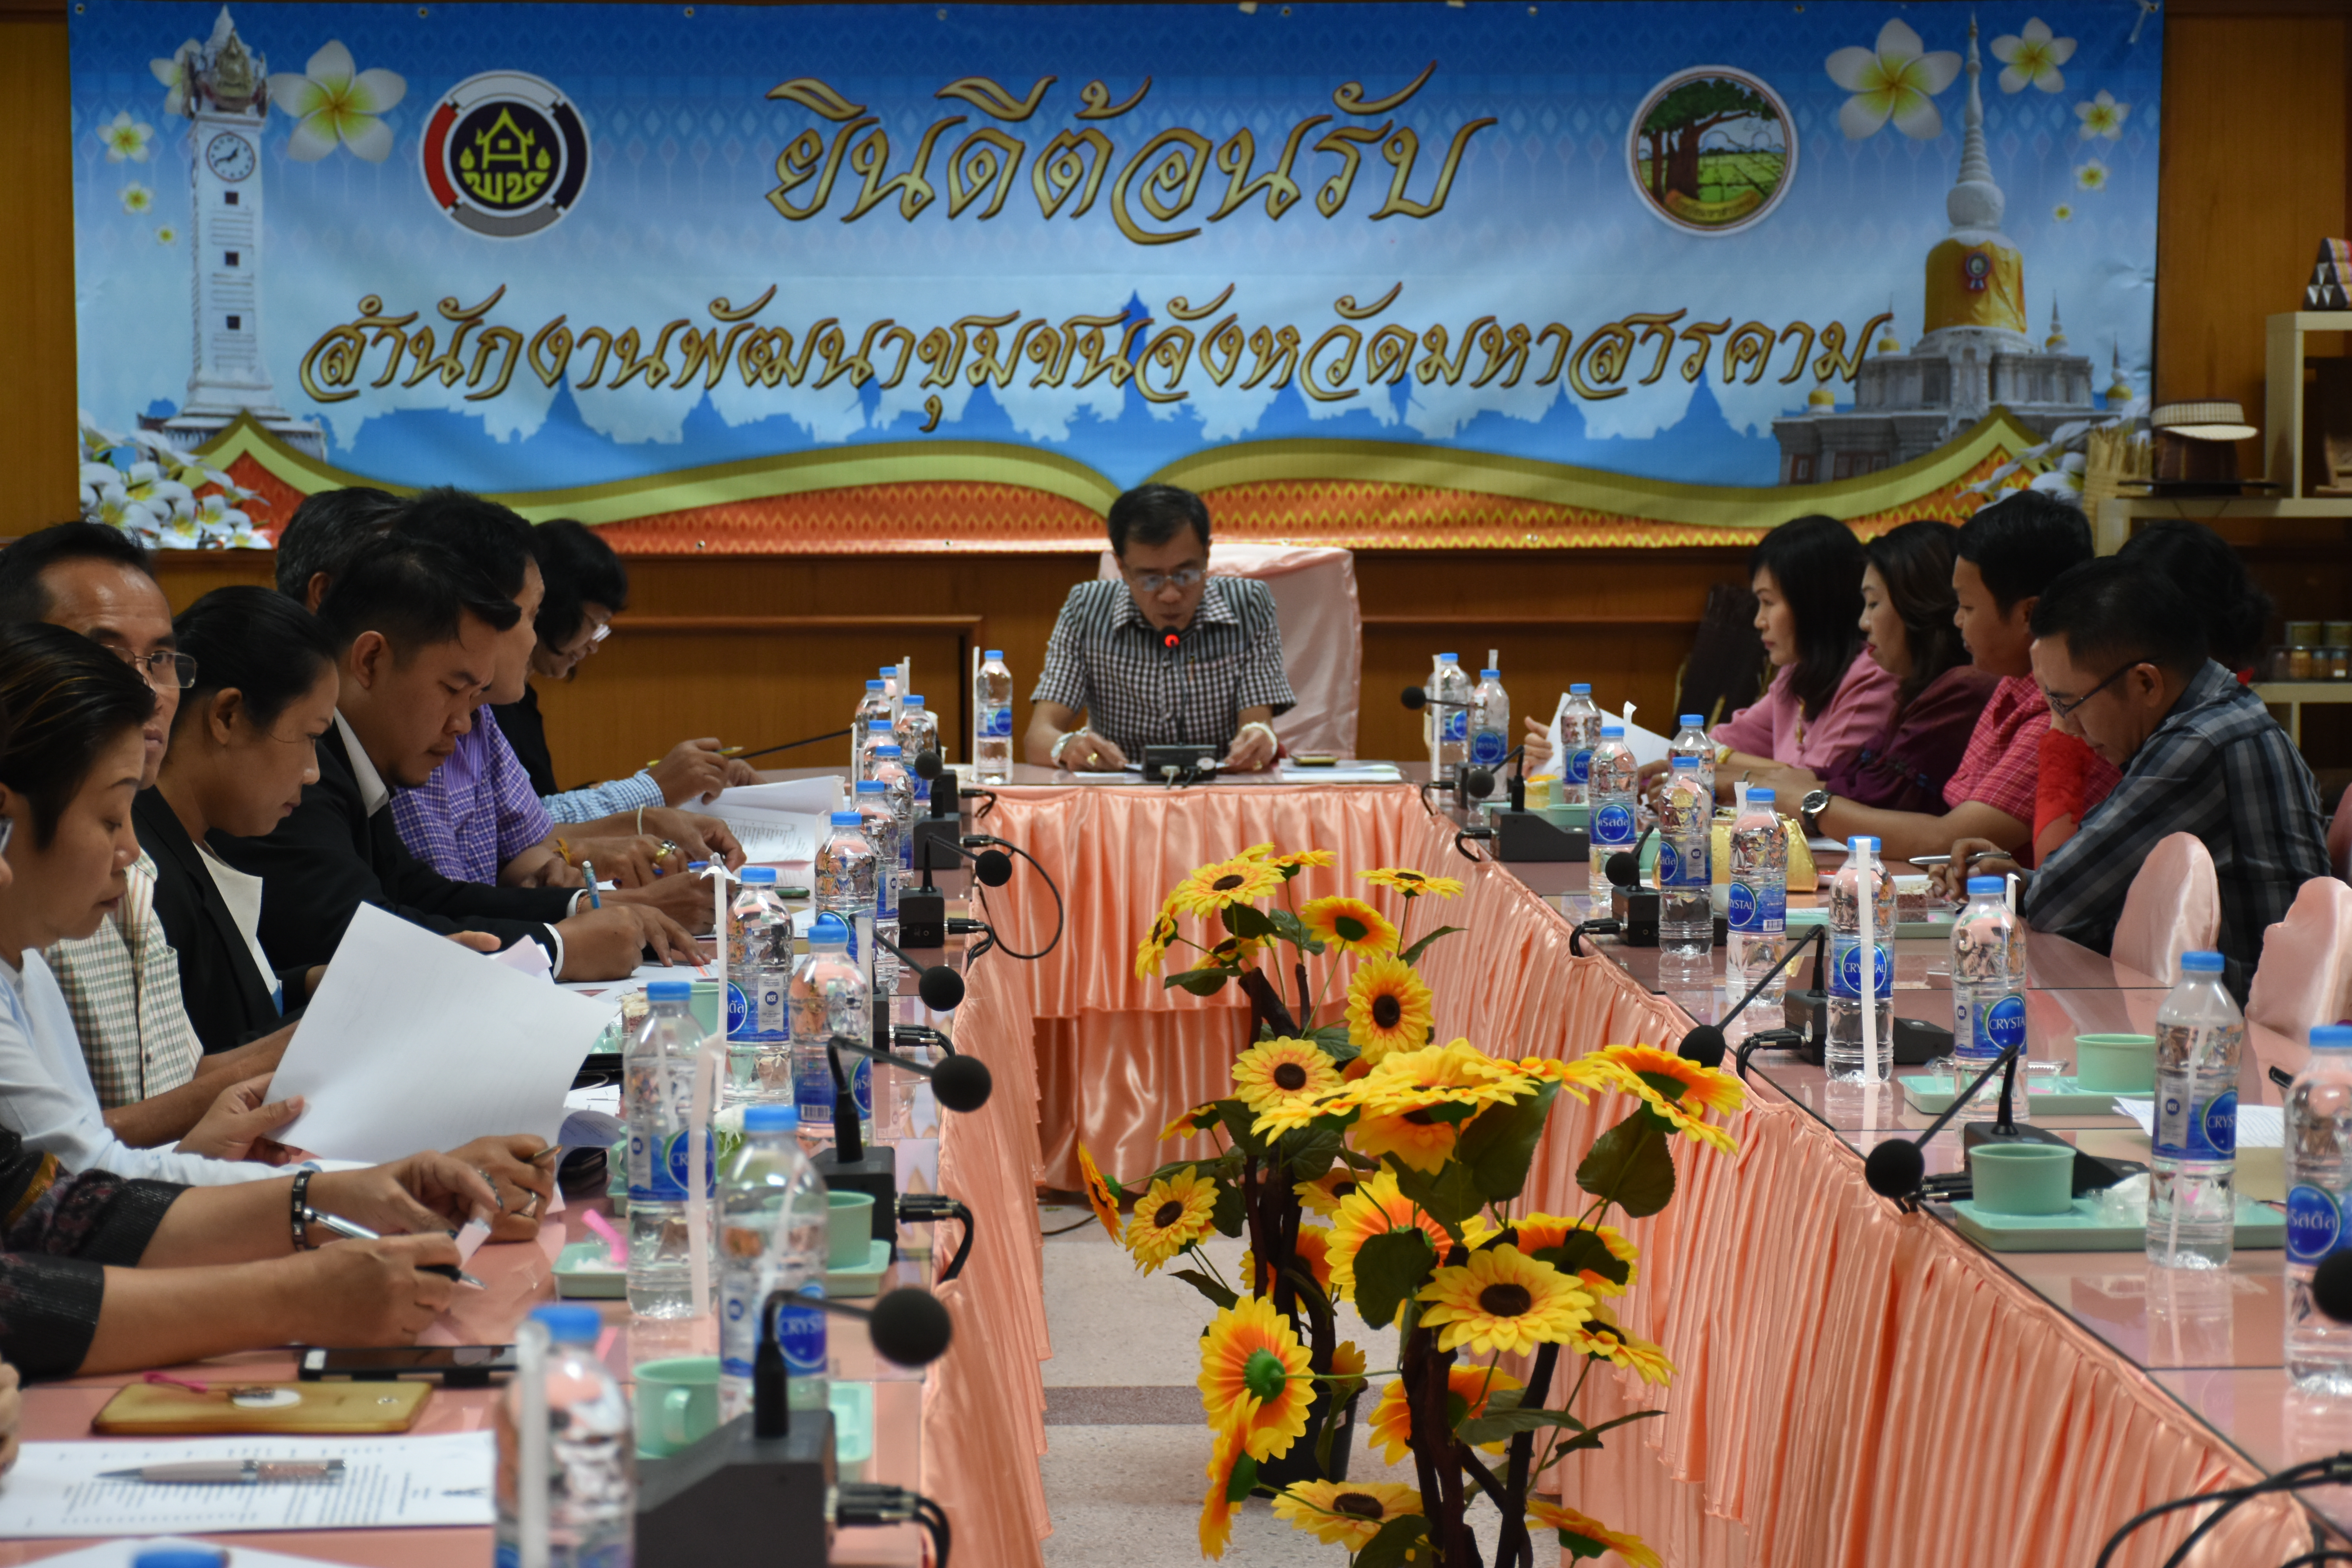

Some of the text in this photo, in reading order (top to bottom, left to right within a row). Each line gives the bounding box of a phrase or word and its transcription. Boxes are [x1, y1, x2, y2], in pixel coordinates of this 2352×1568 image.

[765, 60, 1497, 245] ยินดีต้อนรับ
[299, 283, 1893, 432] สำนักงานพัฒนาชุมชนจังหวัดมหาสารคาม
[1844, 963, 1885, 973] CRYAL
[1989, 1016, 2025, 1030] CRYSTA
[2207, 1115, 2236, 1129] CRYS
